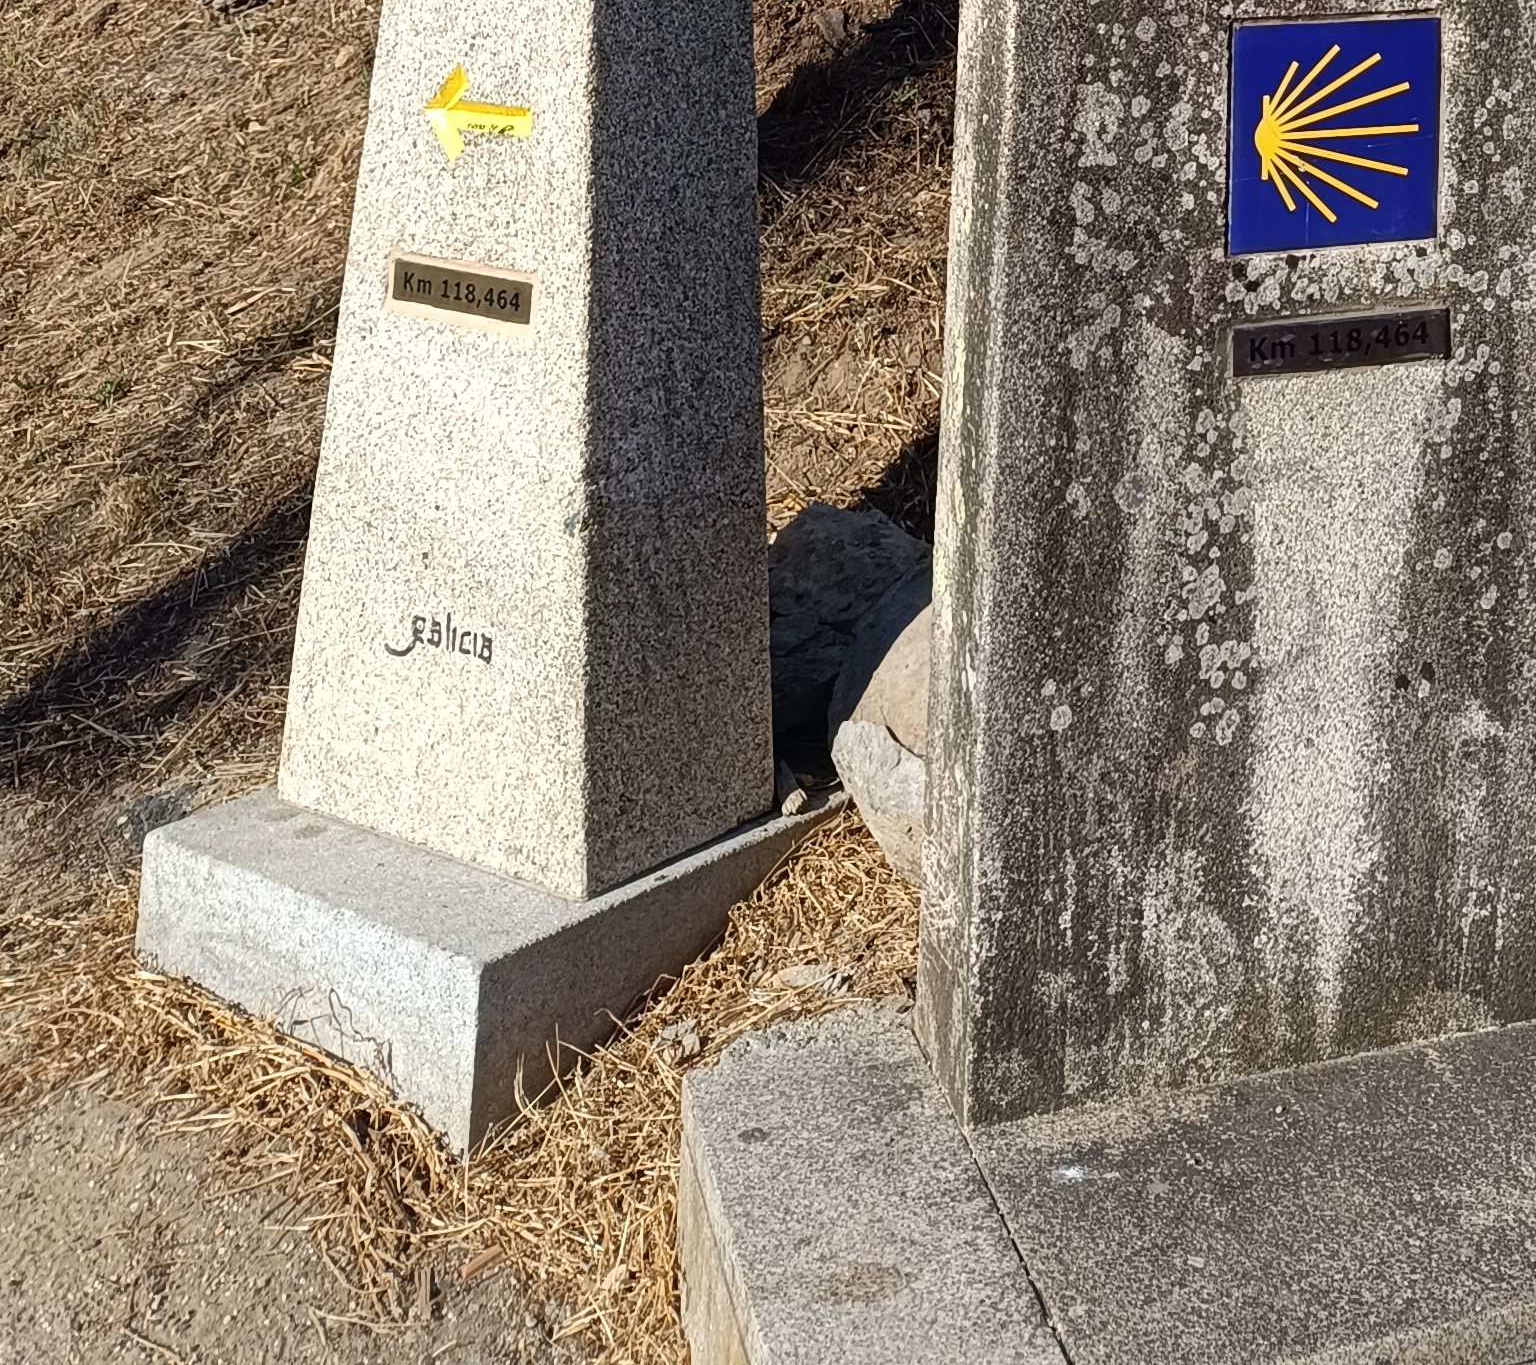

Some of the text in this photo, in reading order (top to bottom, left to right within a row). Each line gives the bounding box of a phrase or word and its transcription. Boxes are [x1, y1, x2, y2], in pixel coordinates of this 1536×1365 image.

[403, 271, 521, 312] Km 118,464
[1250, 321, 1430, 362] Km 118,464
